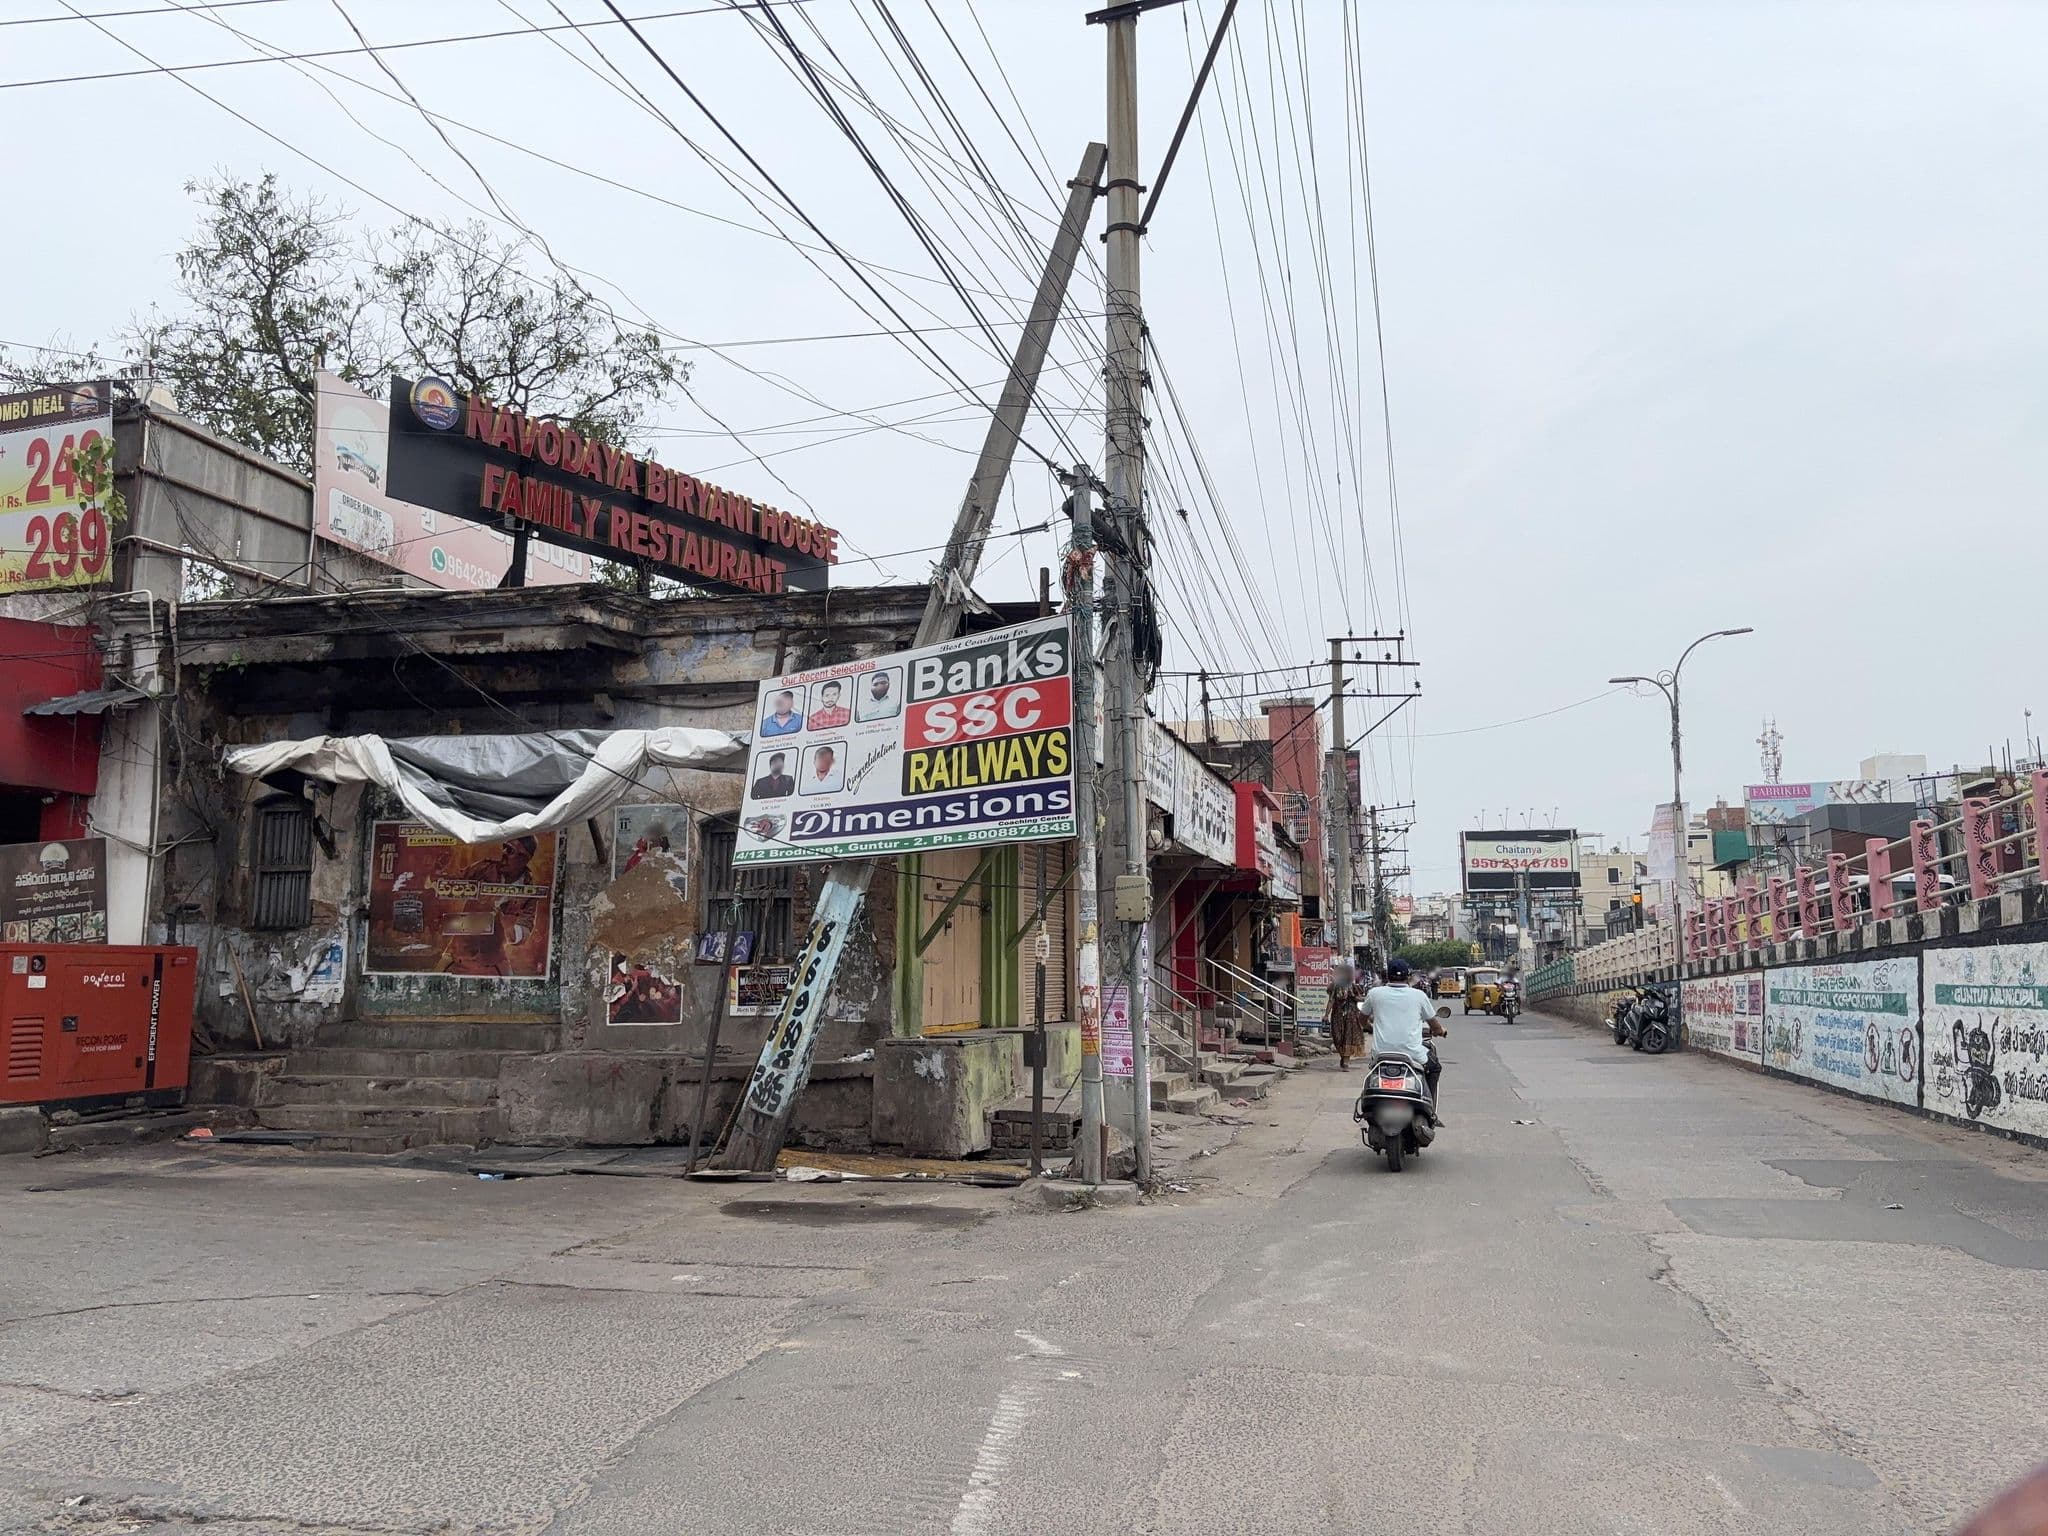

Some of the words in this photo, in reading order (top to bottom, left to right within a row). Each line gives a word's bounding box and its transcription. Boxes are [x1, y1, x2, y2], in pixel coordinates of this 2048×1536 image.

[32, 393, 65, 417] MEAL
[465, 393, 640, 495] NAVODAYA
[645, 460, 754, 535] BIRYANI
[759, 502, 839, 565] HOUSE
[7, 495, 22, 508] Rs.
[342, 494, 361, 512] ORDER
[26, 508, 107, 580] 299
[480, 463, 603, 540] FAMILY
[608, 504, 787, 593] RESTAURANT
[939, 642, 962, 652] Best
[964, 633, 1009, 647] Coaching
[1013, 628, 1029, 640] for
[781, 675, 801, 687] Our
[800, 667, 829, 684] Recent
[830, 660, 876, 676] Selections
[914, 639, 1064, 700] Banks
[922, 687, 1041, 743] SSC
[909, 735, 1068, 793] RAILWAYS
[1752, 785, 1809, 797] FABRIKHA
[791, 788, 1070, 837] Dimensions
[998, 817, 1038, 827] Coaching
[736, 849, 765, 860] 4/12
[847, 839, 900, 853] Guntur
[913, 835, 928, 847] 2.
[933, 833, 953, 844] Ph
[967, 821, 1071, 841] 8008874848
[1495, 844, 1542, 856] Chaitanya
[1501, 857, 1528, 868] 234
[151, 979, 161, 1015] POWER
[148, 1017, 158, 1061] EFFICIENT
